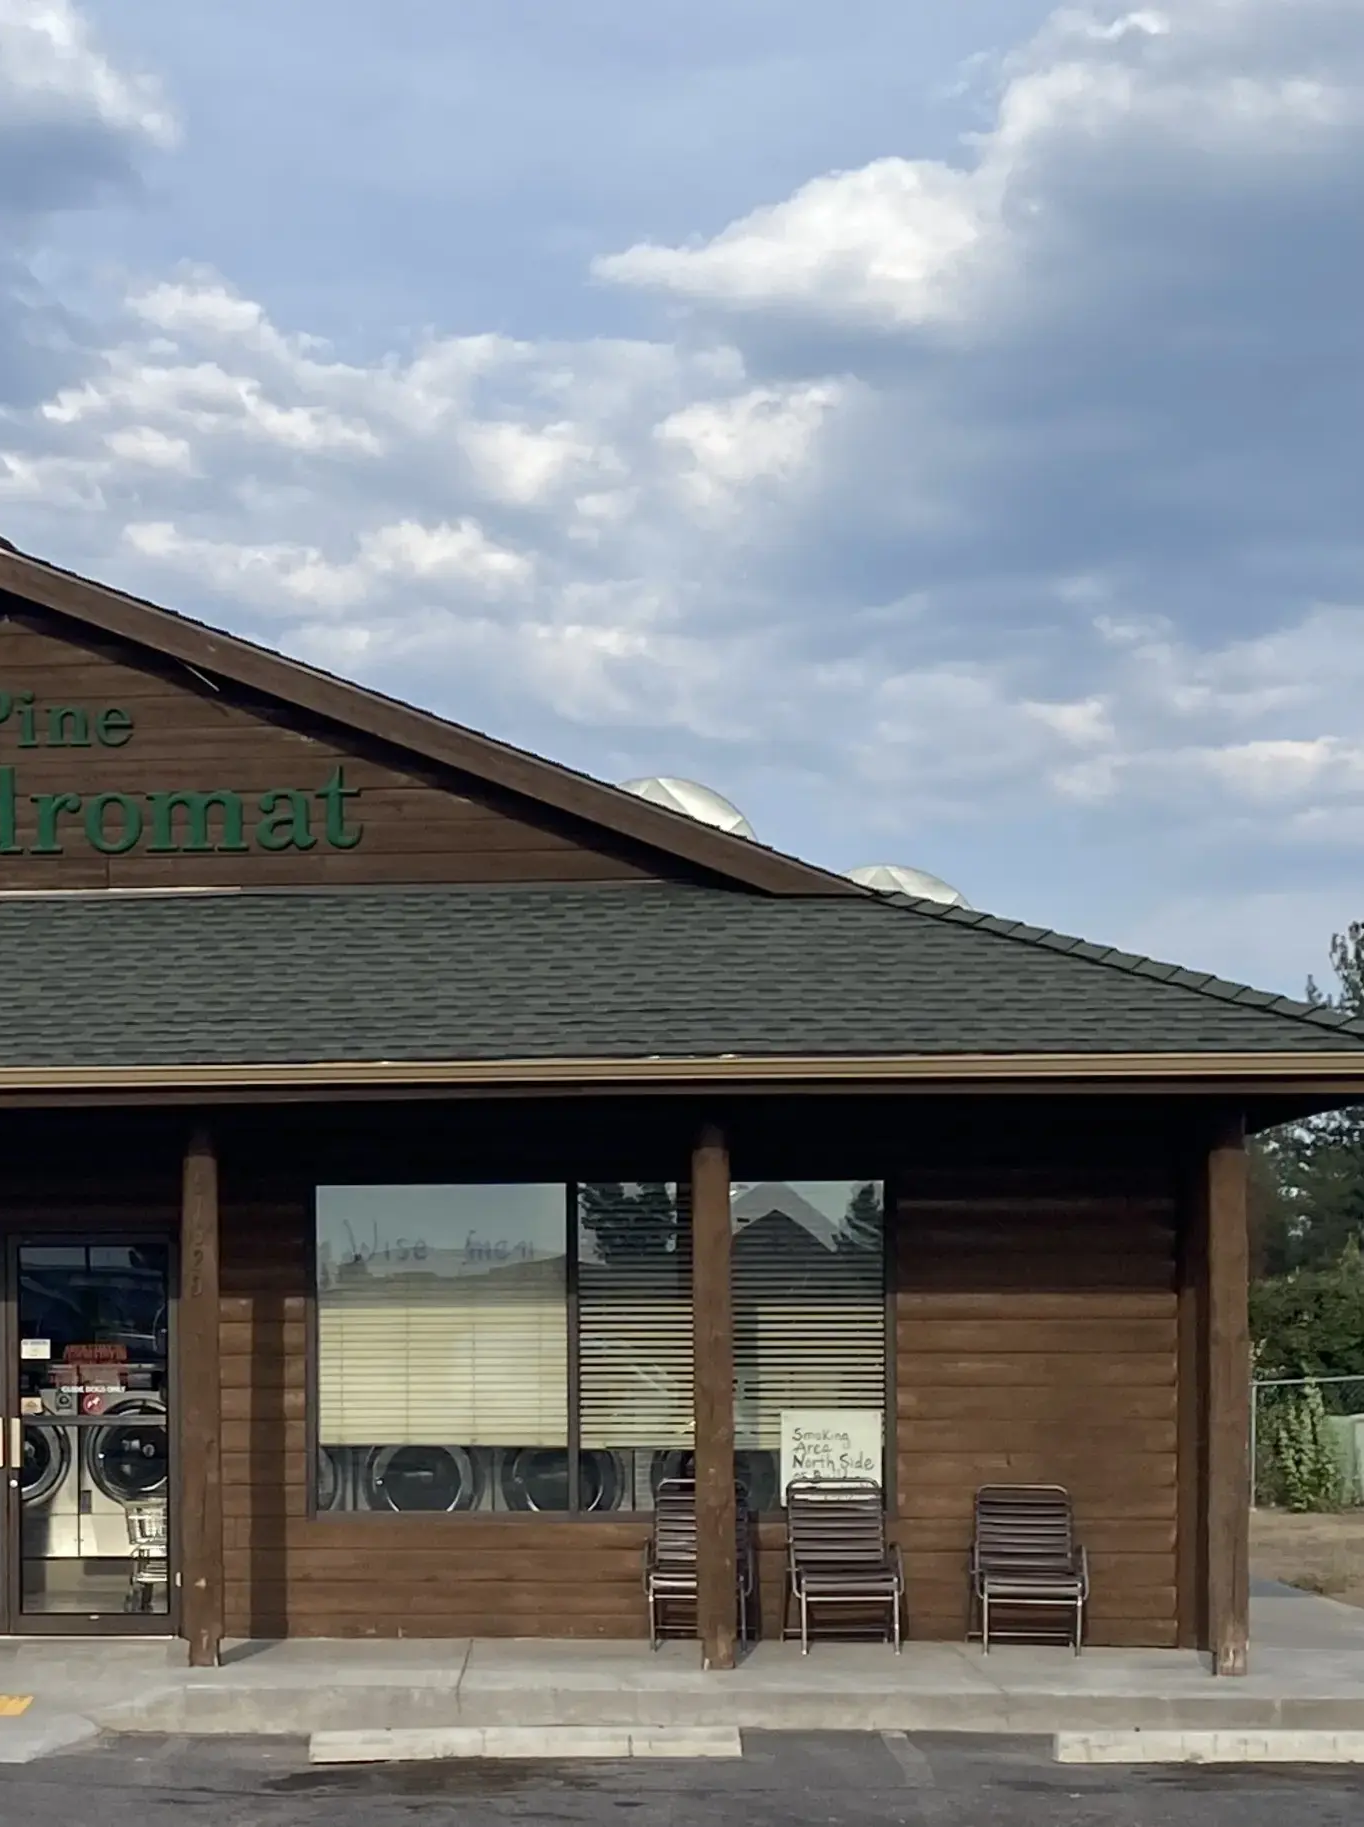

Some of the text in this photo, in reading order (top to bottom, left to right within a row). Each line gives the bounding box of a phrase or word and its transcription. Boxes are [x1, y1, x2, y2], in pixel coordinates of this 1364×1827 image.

[792, 1427, 851, 1449] Smoking
[792, 1441, 833, 1455] Area
[792, 1450, 875, 1471] North Side
